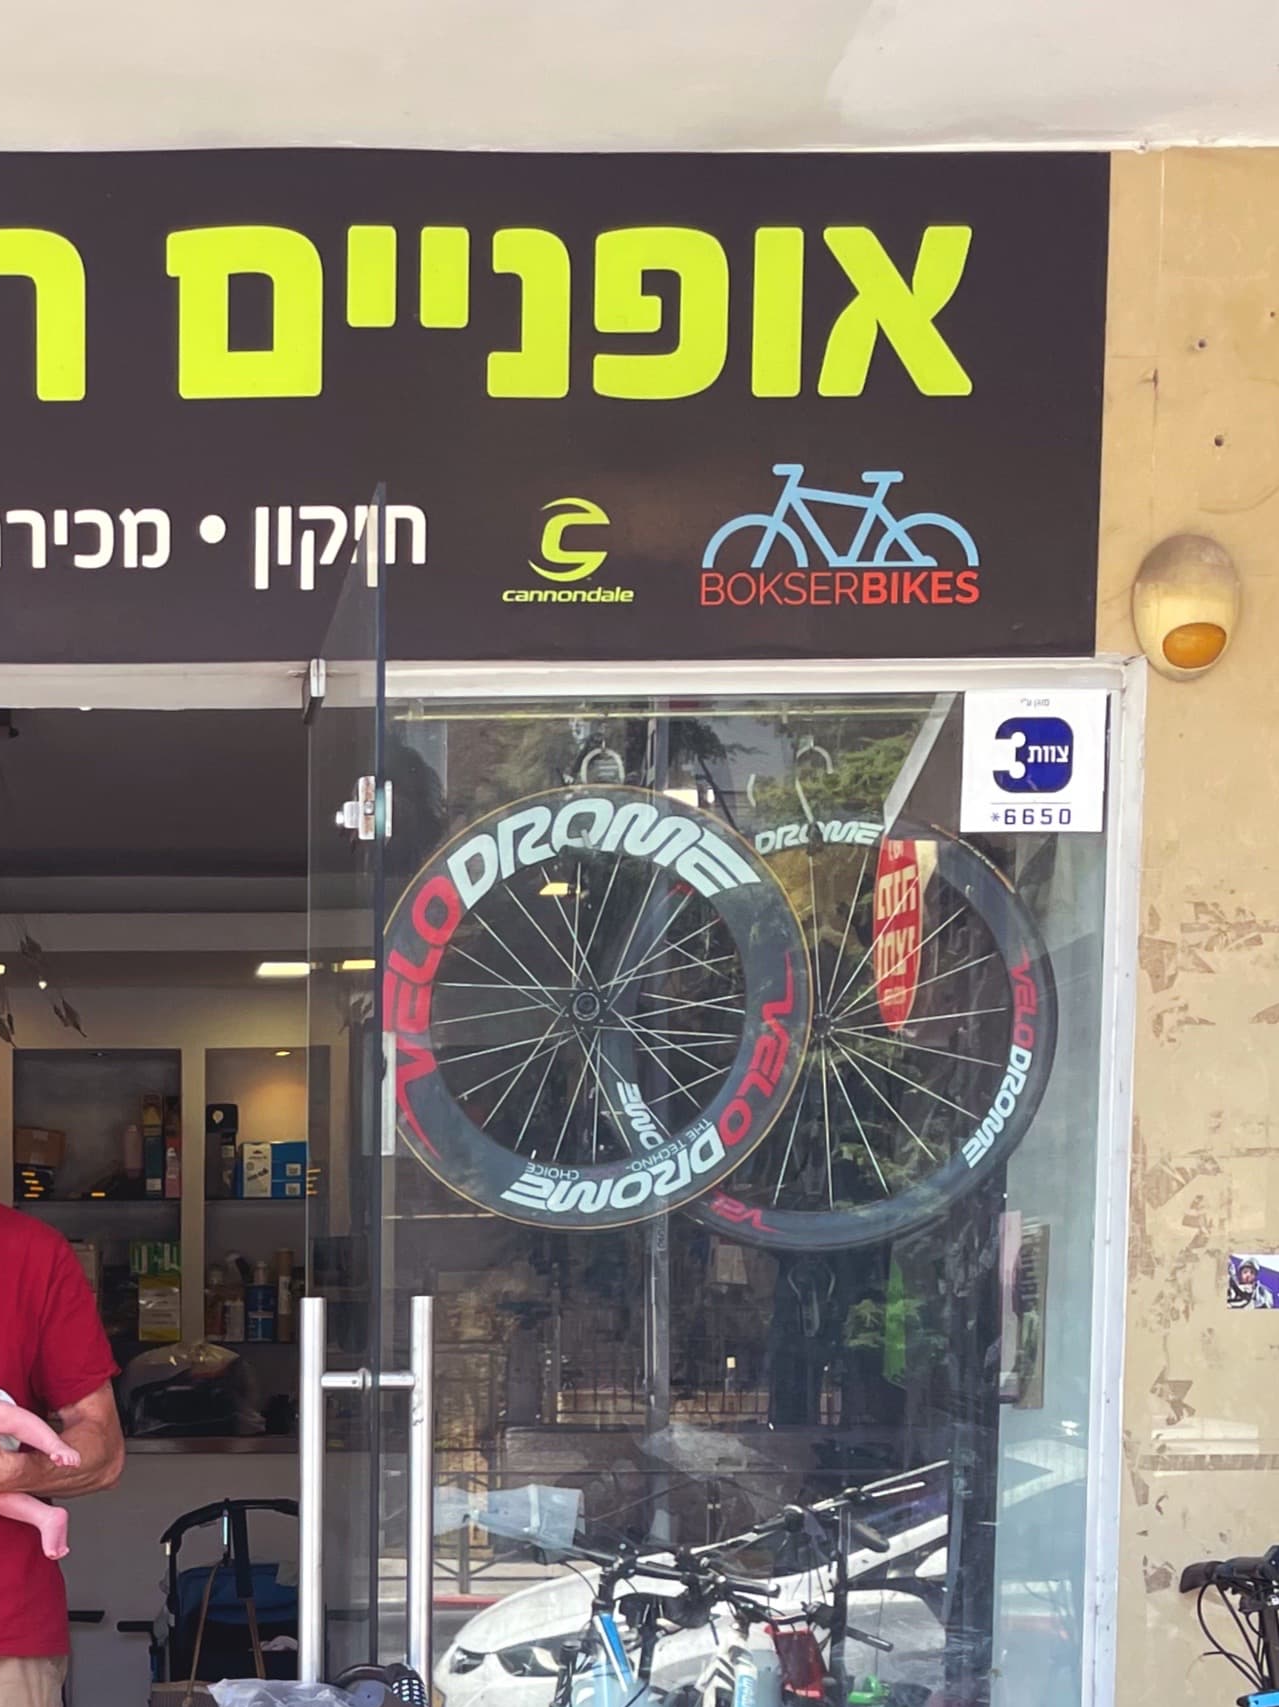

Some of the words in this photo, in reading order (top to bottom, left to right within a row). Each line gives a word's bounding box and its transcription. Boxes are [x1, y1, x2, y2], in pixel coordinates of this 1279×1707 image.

[167, 226, 972, 401] אופניים
[502, 588, 634, 604] cannondale
[701, 571, 981, 606] BOKSERBIKES
[1027, 745, 1070, 764] צוות
[685, 1118, 713, 1141] THE
[526, 1161, 581, 1181] CHOICE
